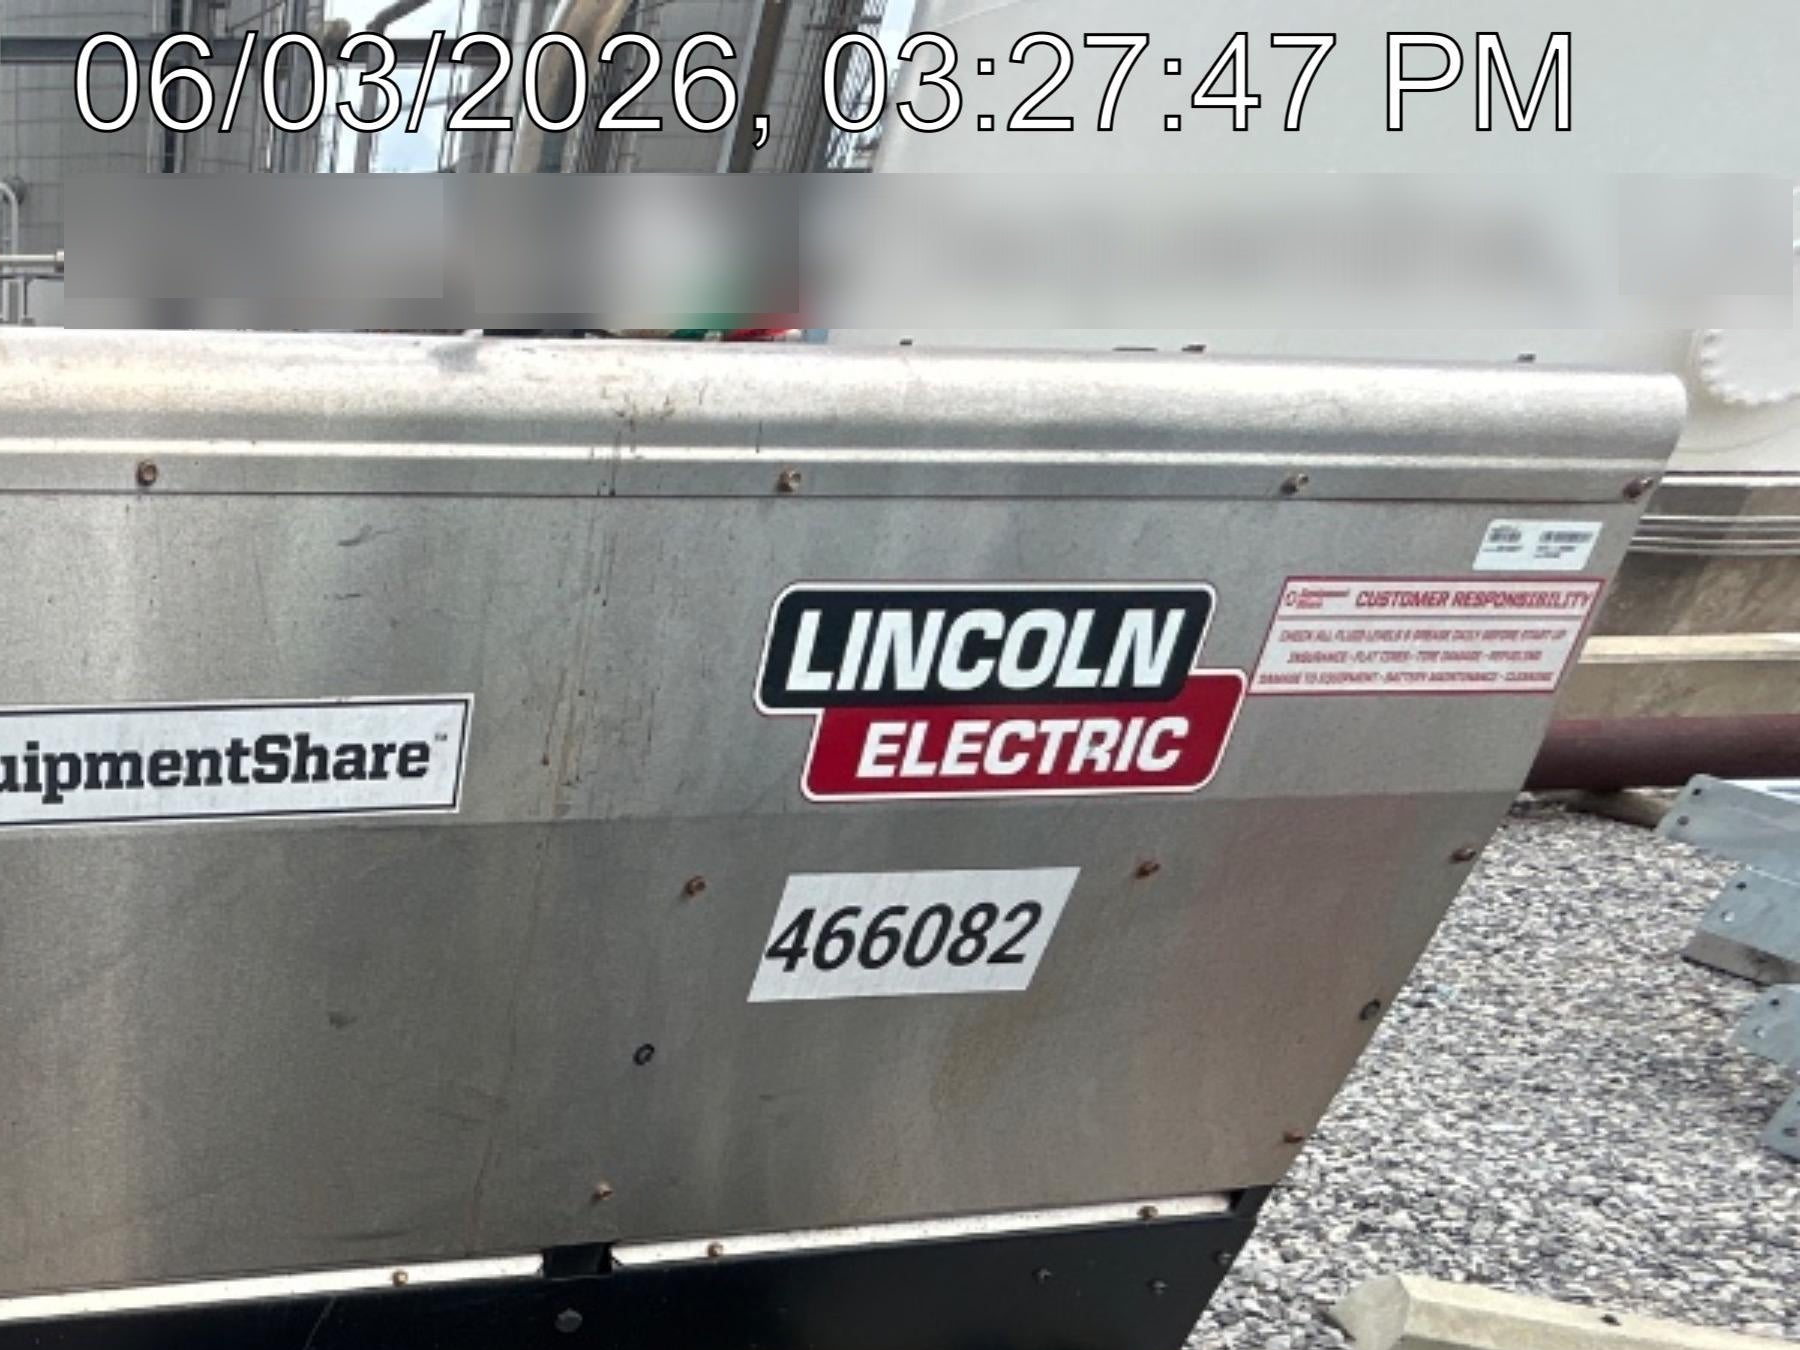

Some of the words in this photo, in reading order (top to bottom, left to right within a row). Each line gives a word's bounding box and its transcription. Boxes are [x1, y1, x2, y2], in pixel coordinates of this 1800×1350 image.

[1355, 590, 1450, 607] CUSTOMER
[1452, 590, 1592, 608] RESPONSIBILITY
[785, 608, 1186, 691] LINCOLN
[856, 716, 1190, 779] ELECTRIC
[765, 900, 1043, 973] 466082
